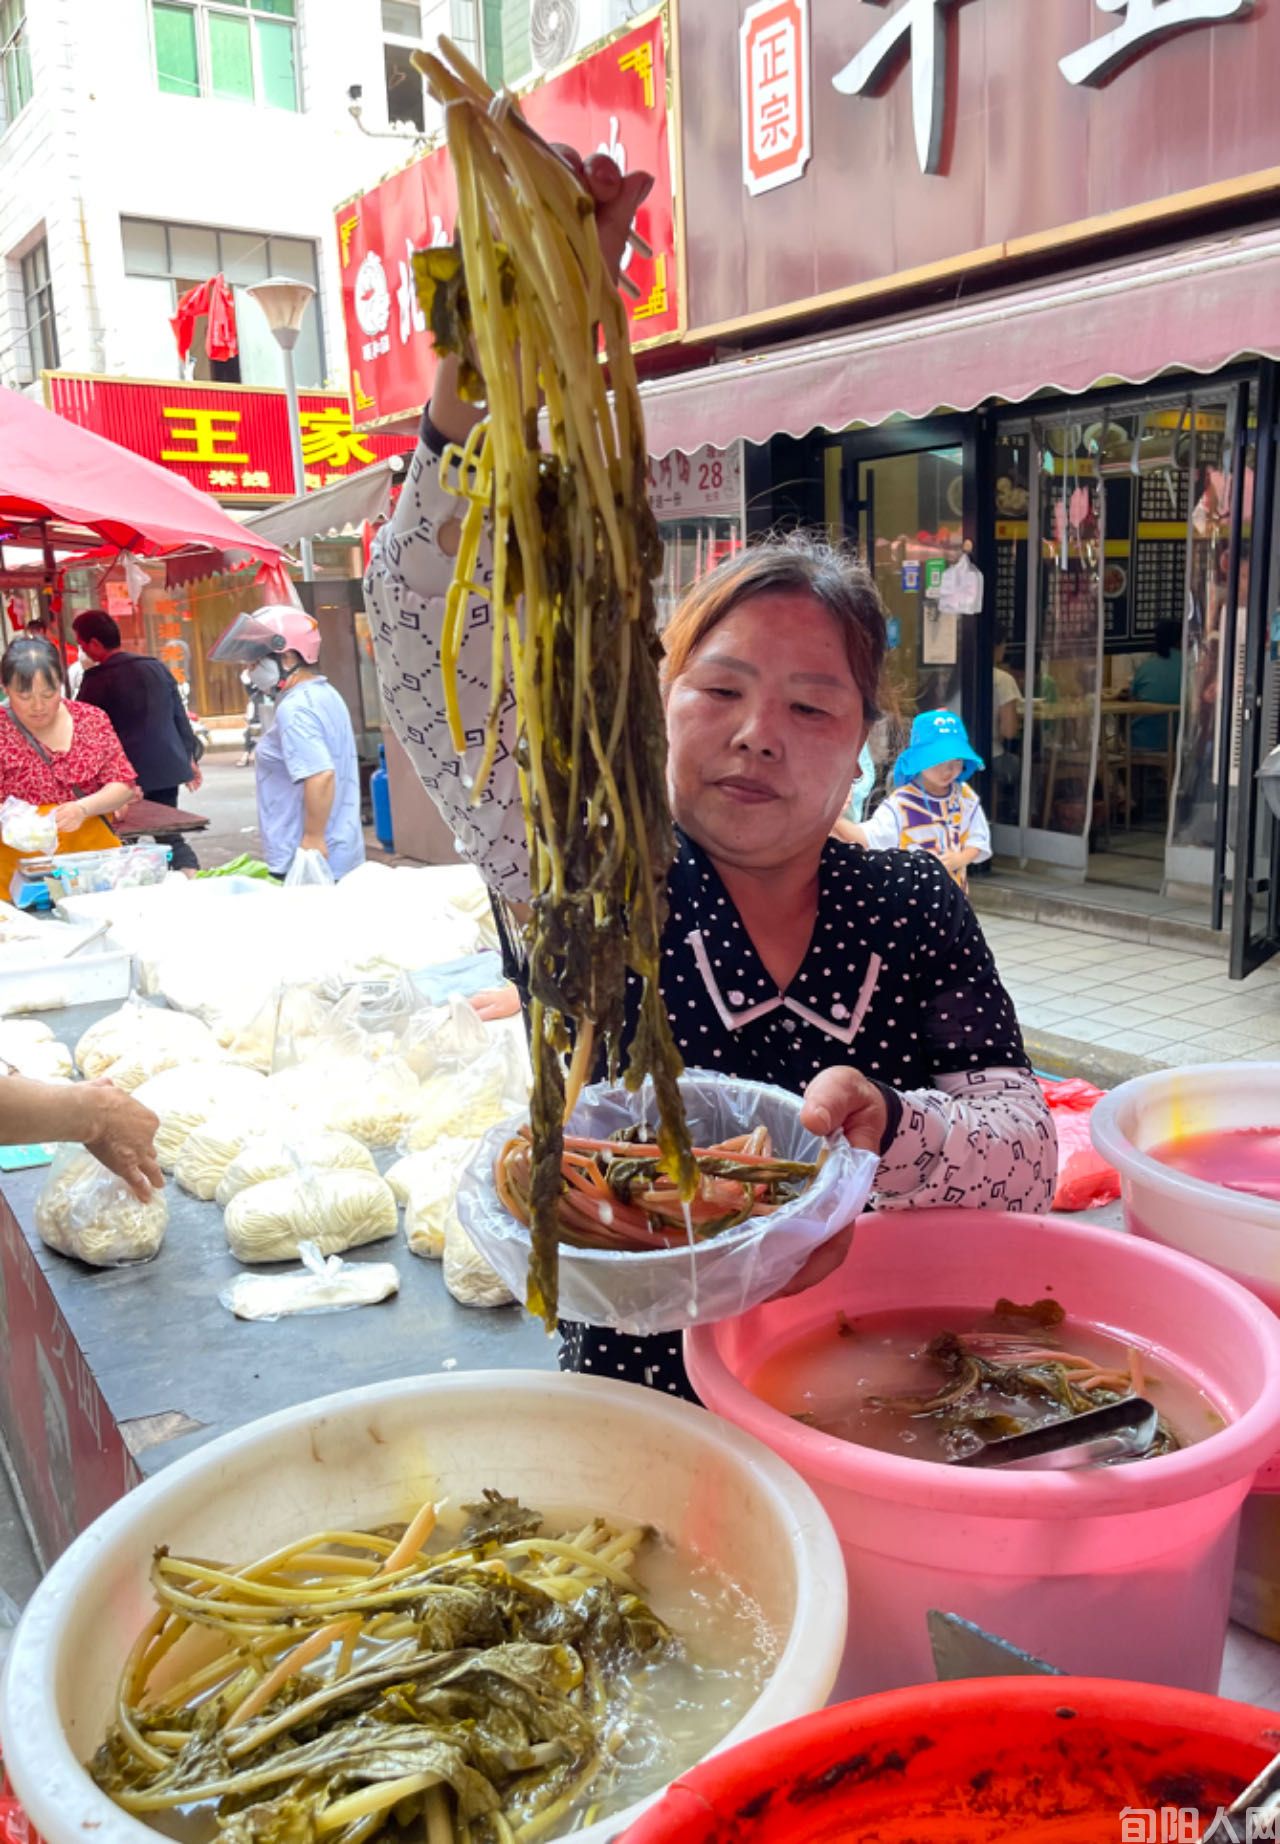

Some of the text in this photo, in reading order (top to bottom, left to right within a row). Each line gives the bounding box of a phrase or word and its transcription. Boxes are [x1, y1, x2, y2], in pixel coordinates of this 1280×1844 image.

[758, 29, 790, 148] 正宗
[161, 407, 377, 467] 王家
[698, 461, 723, 491] 28
